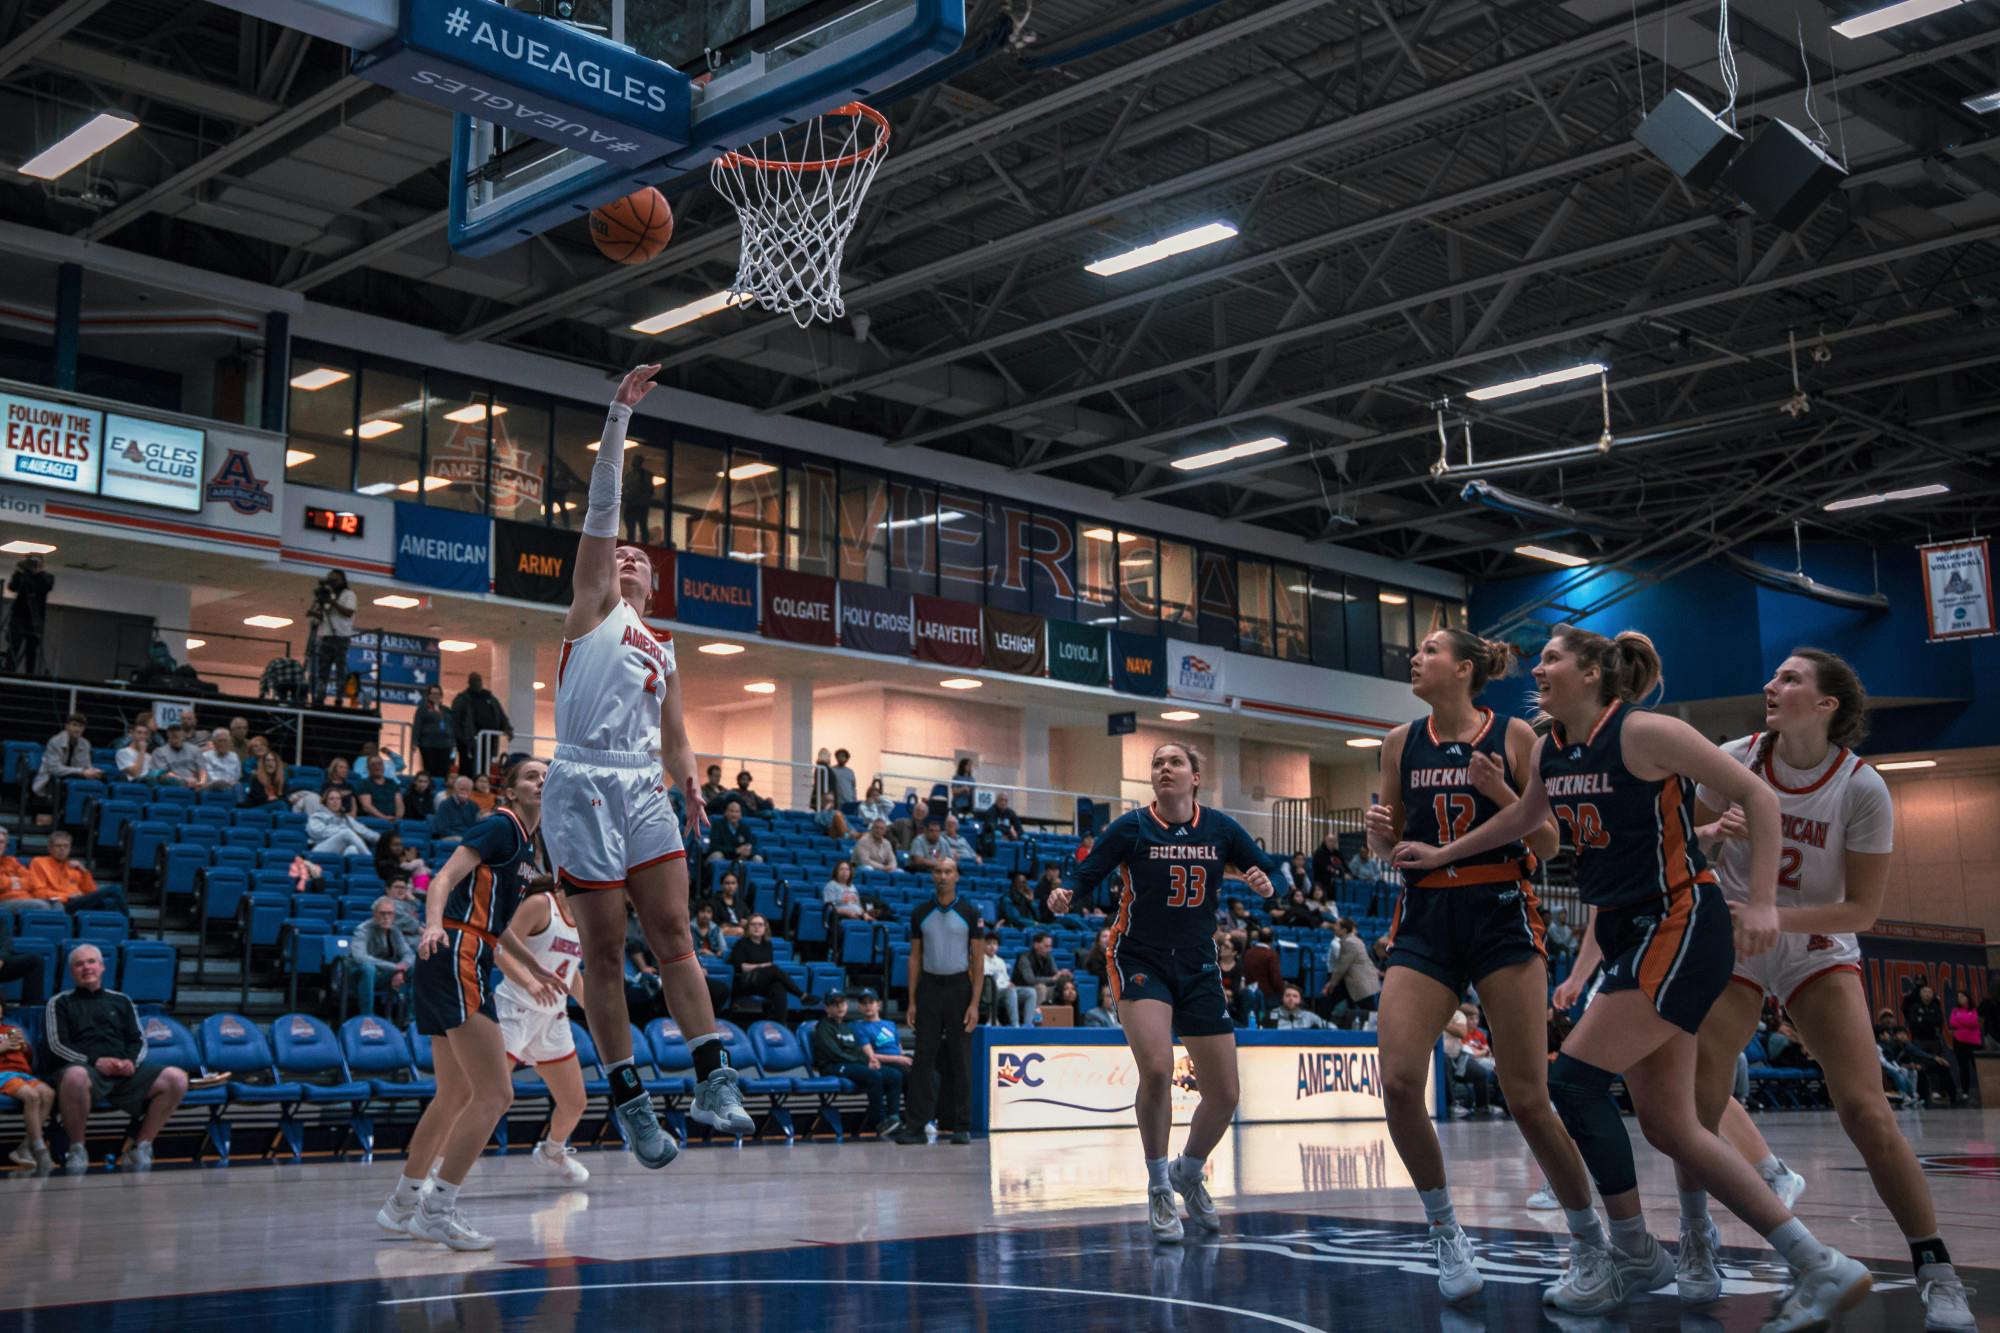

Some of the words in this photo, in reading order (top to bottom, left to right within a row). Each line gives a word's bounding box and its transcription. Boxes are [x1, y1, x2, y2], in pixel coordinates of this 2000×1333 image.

[445, 7, 667, 112] #AUEAGLES
[411, 70, 640, 152] #AUEAGLES
[8, 404, 63, 428] FOLLOW
[67, 414, 91, 433] THE
[7, 422, 89, 462] EAGLES
[145, 459, 195, 478] CLUB
[400, 534, 487, 564] AMERICAN
[518, 552, 563, 577] ARMY
[682, 577, 753, 607] BUCKNELL
[773, 596, 831, 622] COLGATE
[843, 604, 871, 628] HOLY
[874, 612, 912, 634] CROSS
[381, 634, 422, 652] ARENA
[917, 620, 979, 647] LAFAYETTE
[995, 631, 1036, 654] LEHIGH
[1059, 644, 1099, 664] LOYOLA
[1126, 656, 1153, 676] NAVY
[1432, 793, 1476, 844] 12
[1149, 846, 1218, 860] BUCKNELL
[1167, 865, 1207, 908] 33
[555, 959, 570, 979] 4
[1296, 1052, 1384, 1100] AMERICAN
